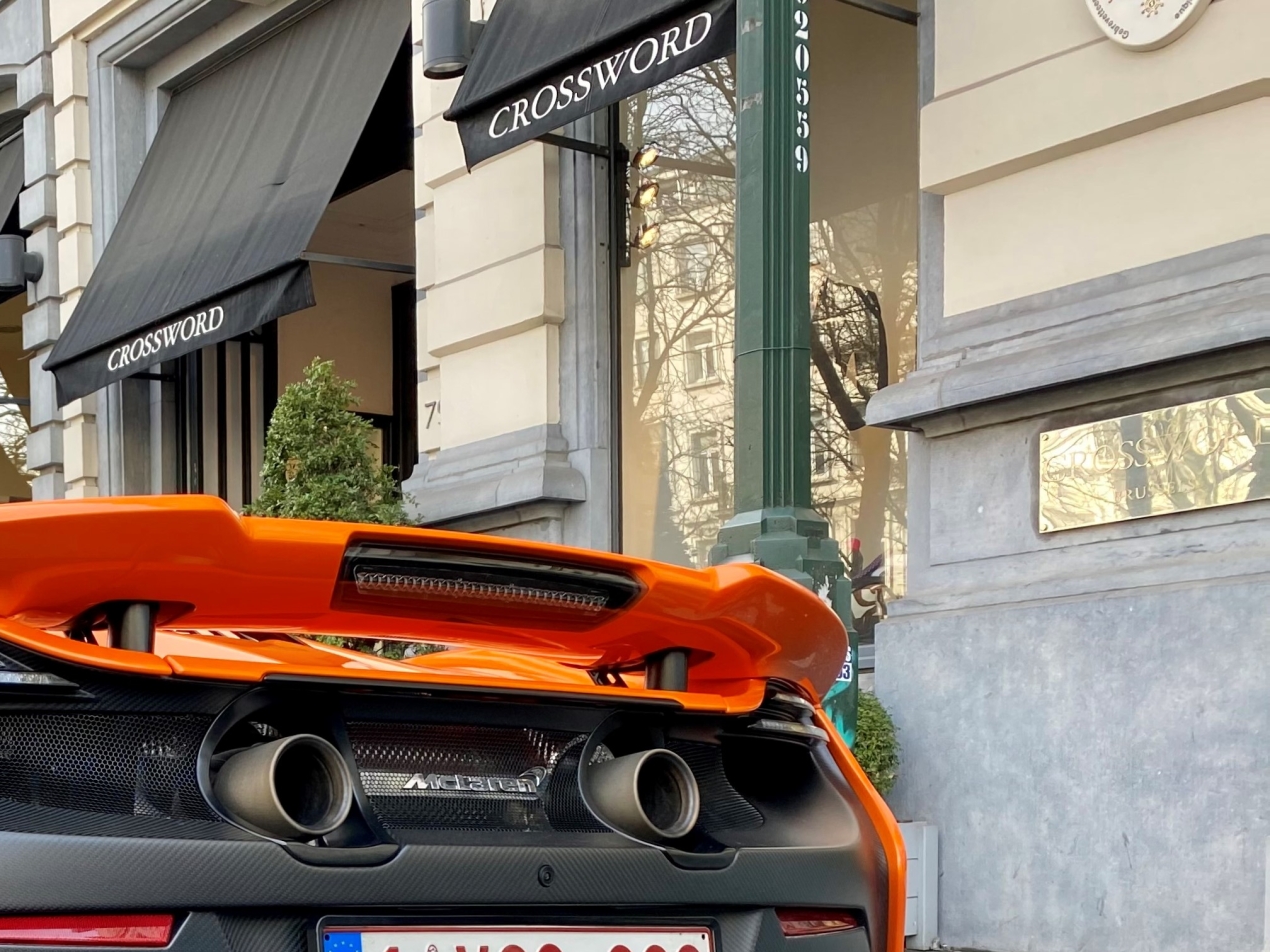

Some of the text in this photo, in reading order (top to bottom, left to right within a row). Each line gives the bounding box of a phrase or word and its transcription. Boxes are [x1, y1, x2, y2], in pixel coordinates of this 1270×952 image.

[488, 12, 712, 138] CROSSWORD
[794, 0, 810, 173] 20559
[107, 305, 225, 371] CROSSWORD
[403, 773, 537, 793] McLaren
